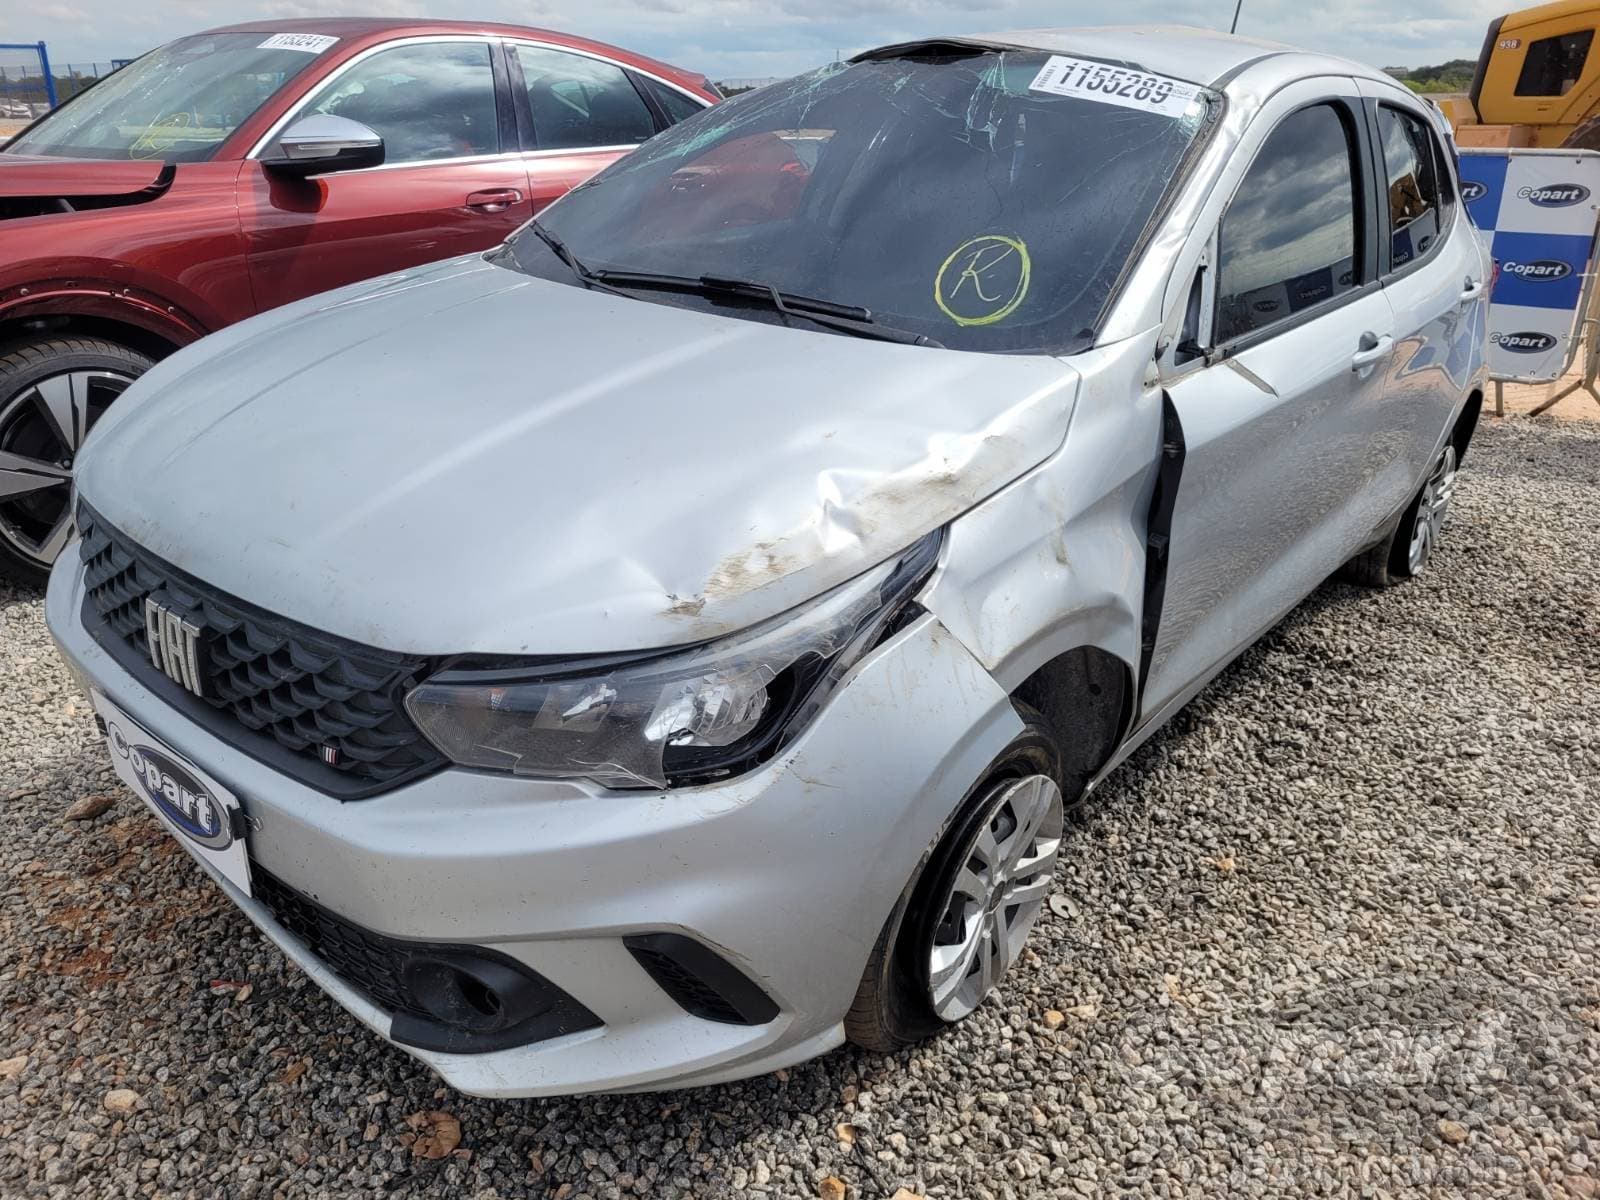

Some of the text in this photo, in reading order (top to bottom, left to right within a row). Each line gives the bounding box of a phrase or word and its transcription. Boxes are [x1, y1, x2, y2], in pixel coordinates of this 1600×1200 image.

[1500, 39, 1517, 49] 938
[1059, 62, 1174, 104] 1155289
[1517, 186, 1580, 204] Copart
[1502, 260, 1563, 277] Copart
[1489, 331, 1547, 348] Copart
[145, 597, 203, 698] FIAT
[108, 721, 214, 837] Copart
